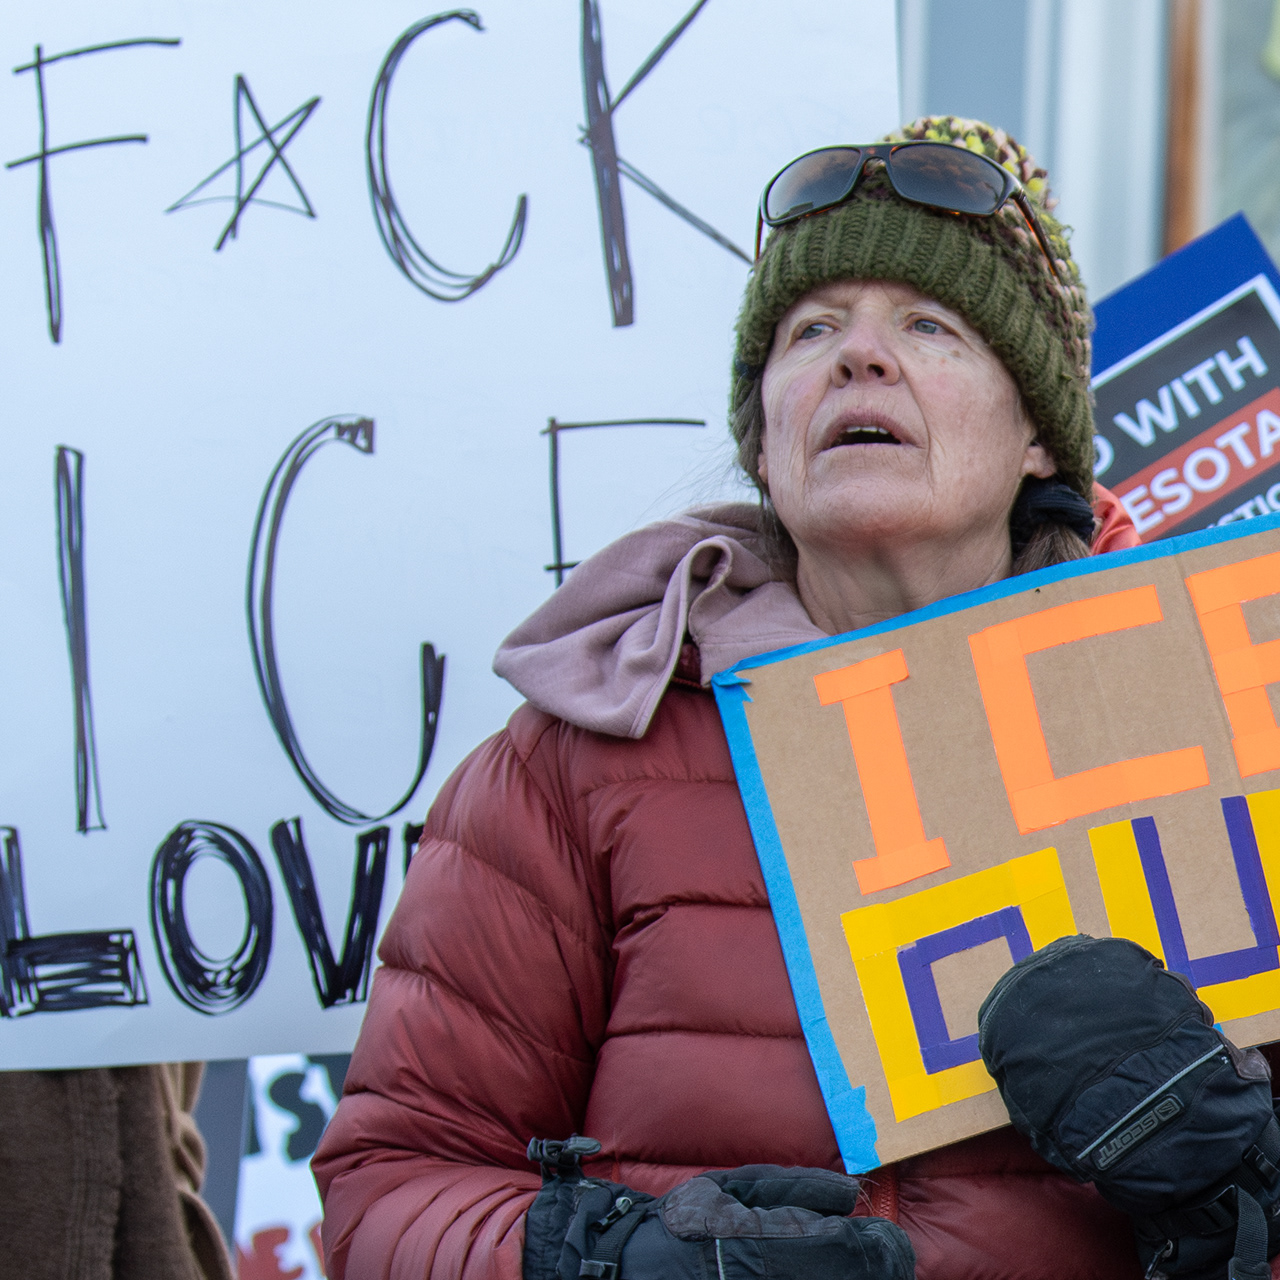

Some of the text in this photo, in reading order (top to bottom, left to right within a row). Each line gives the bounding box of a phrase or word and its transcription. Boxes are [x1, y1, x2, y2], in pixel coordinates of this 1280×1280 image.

[1113, 335, 1269, 447] WITH
[0, 816, 425, 1018] LOV
[1098, 1110, 1160, 1170] SCOTT
